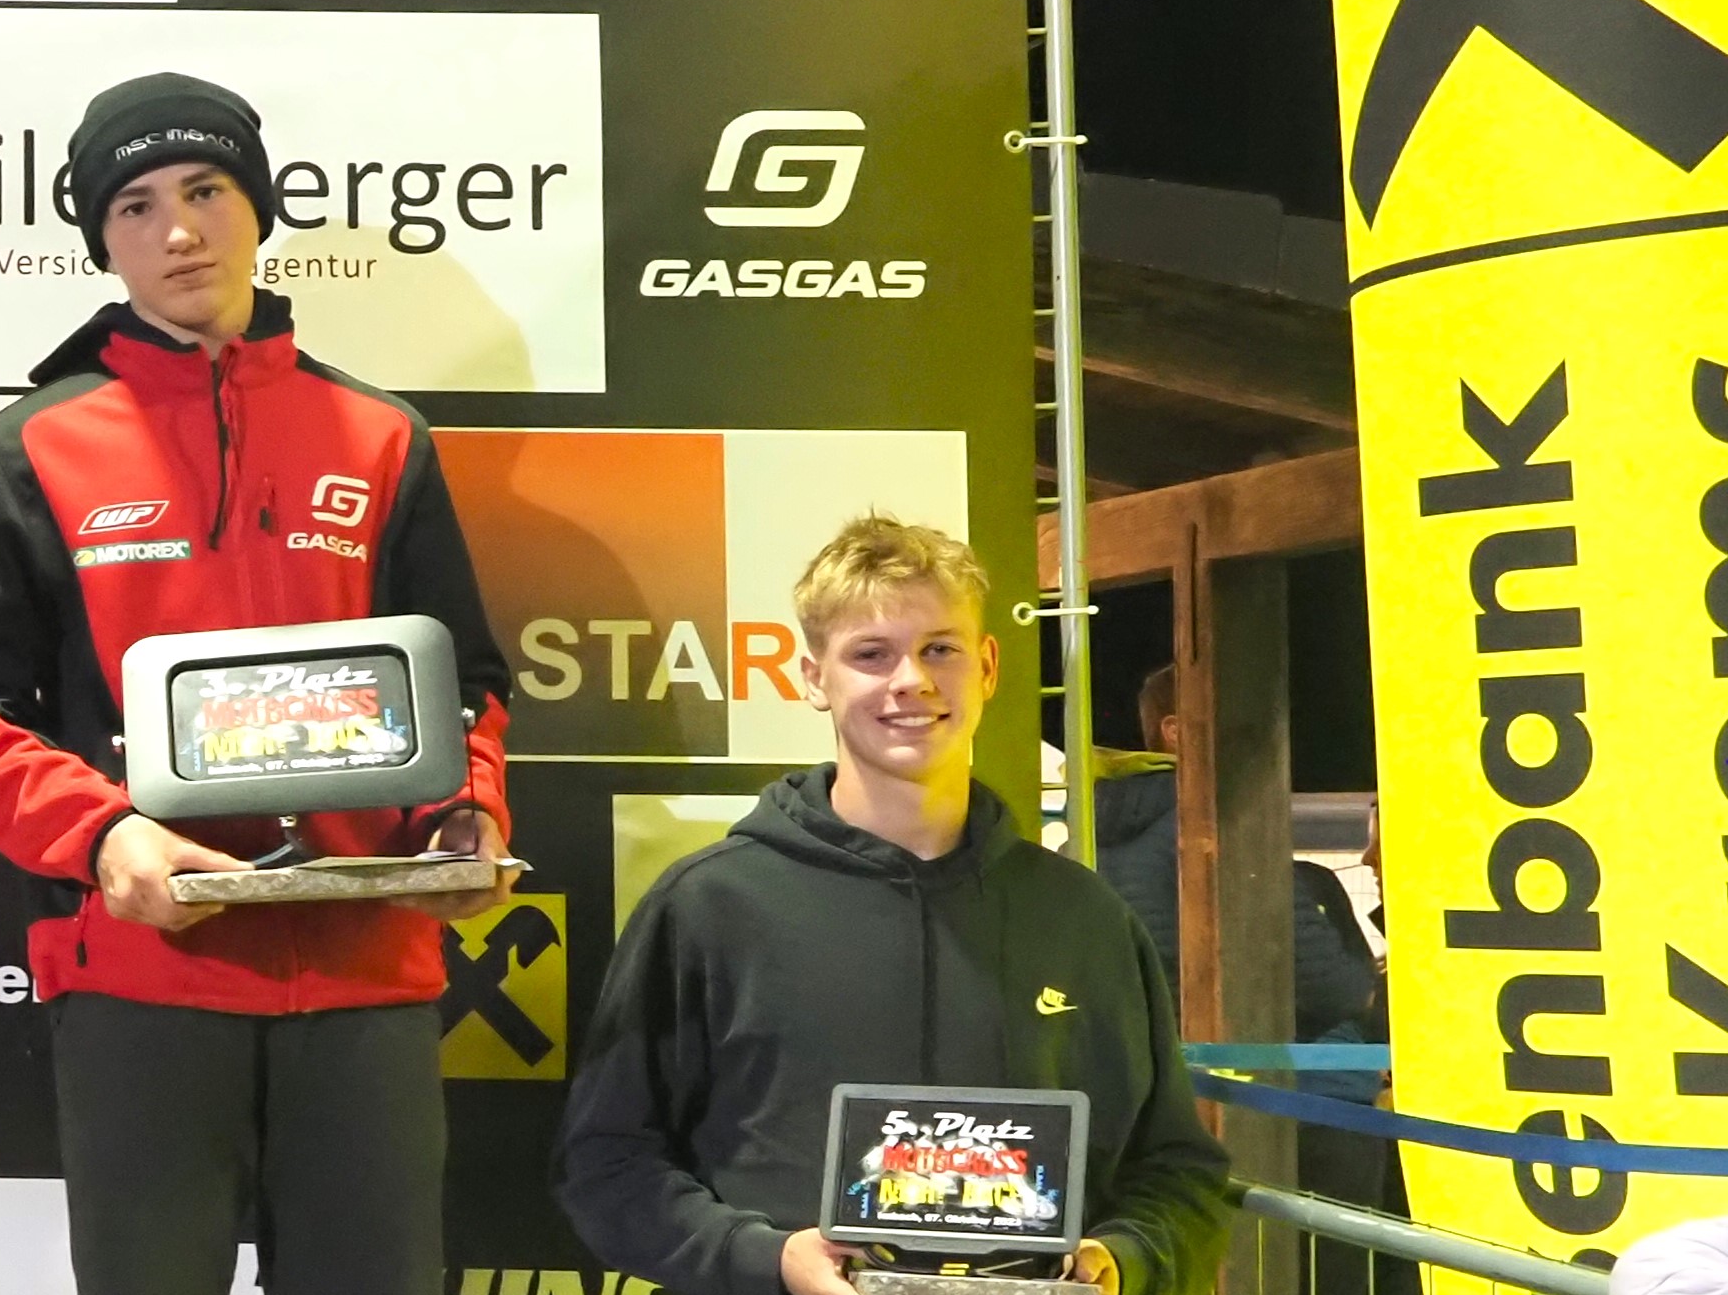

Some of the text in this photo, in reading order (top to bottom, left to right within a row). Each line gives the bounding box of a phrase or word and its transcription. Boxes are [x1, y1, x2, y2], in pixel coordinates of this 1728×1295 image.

[640, 259, 927, 300] GASGAS
[95, 541, 188, 564] MOTOREX
[286, 532, 367, 563] GASGA
[256, 665, 378, 695] Platz
[933, 1111, 1035, 1141] Platz
